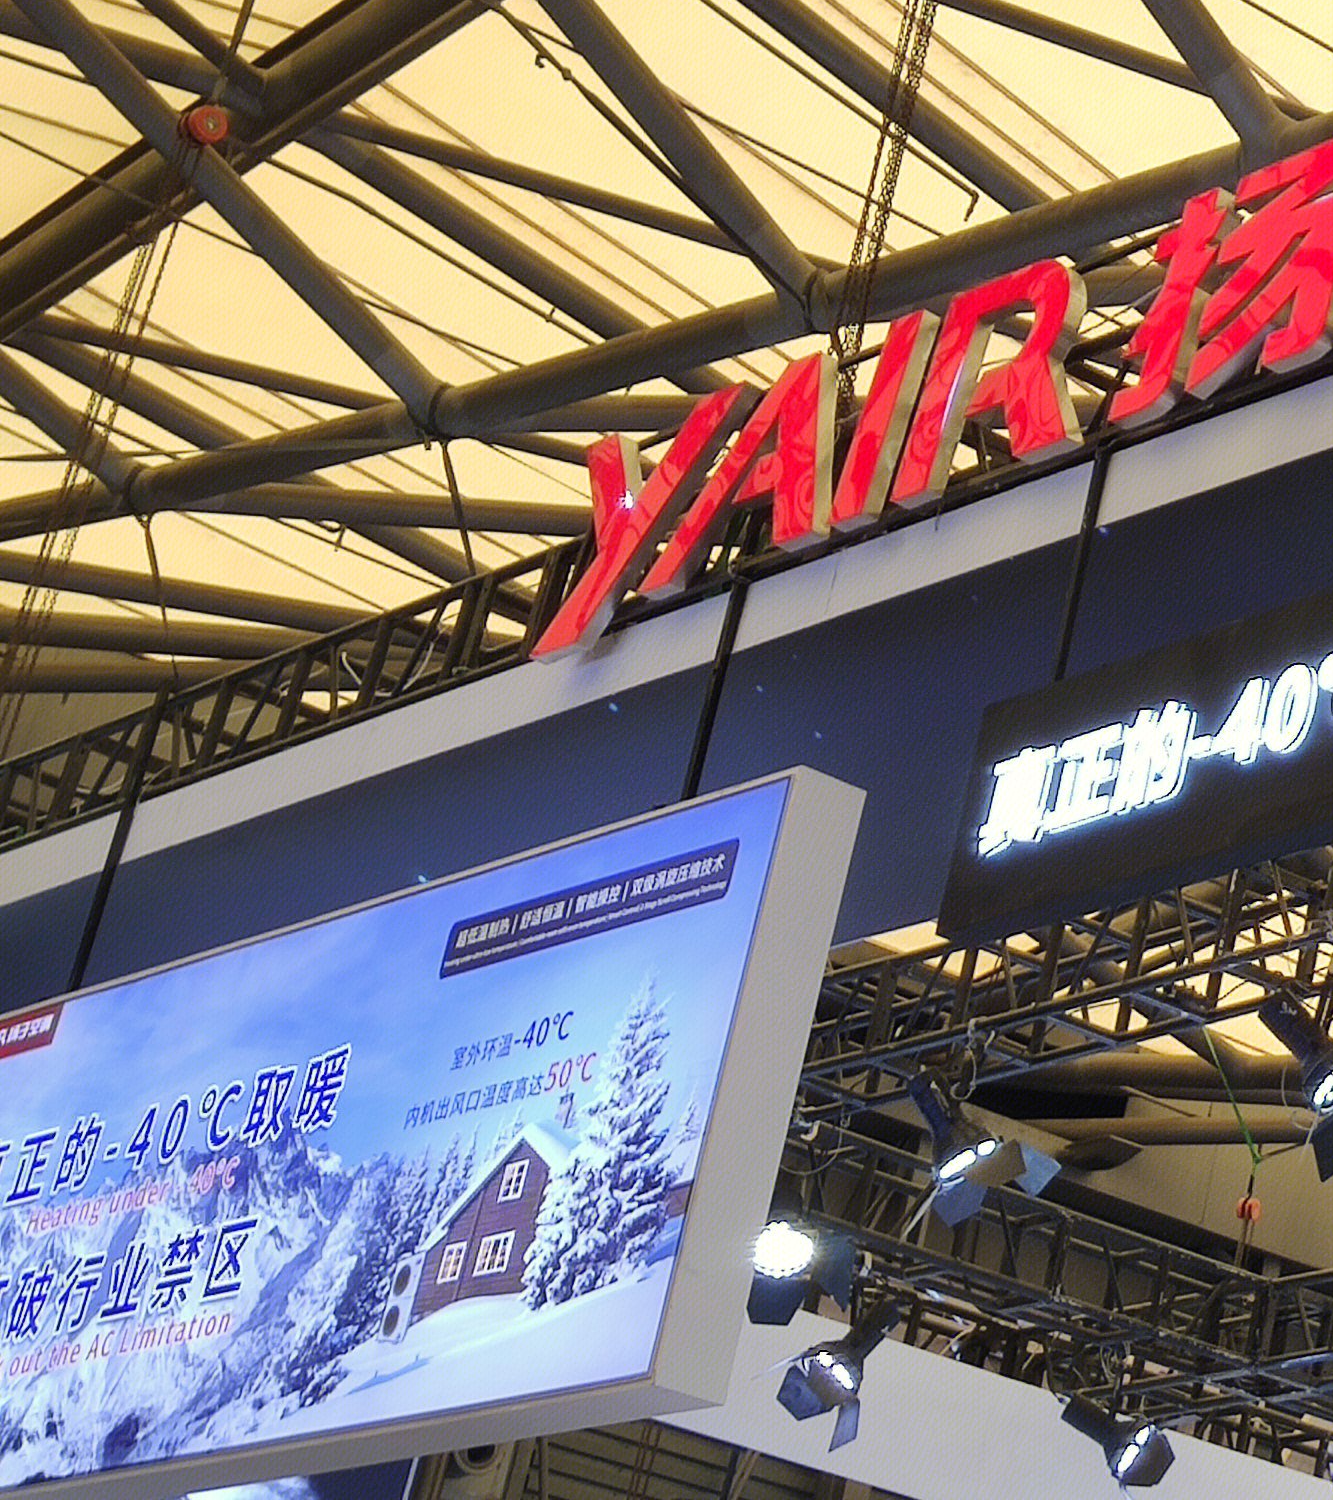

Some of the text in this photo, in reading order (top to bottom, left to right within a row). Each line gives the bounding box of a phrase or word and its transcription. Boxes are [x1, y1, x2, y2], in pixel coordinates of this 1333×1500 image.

[531, 254, 1085, 663] YAIR
[0, 1046, 350, 1203] 正的-40℃取暖
[26, 1200, 101, 1235] Heating
[109, 1176, 170, 1214] under
[0, 1218, 258, 1339] 破行业禁区
[48, 1340, 81, 1368] the
[86, 1330, 116, 1361] AC
[120, 1310, 232, 1354] Limitation
